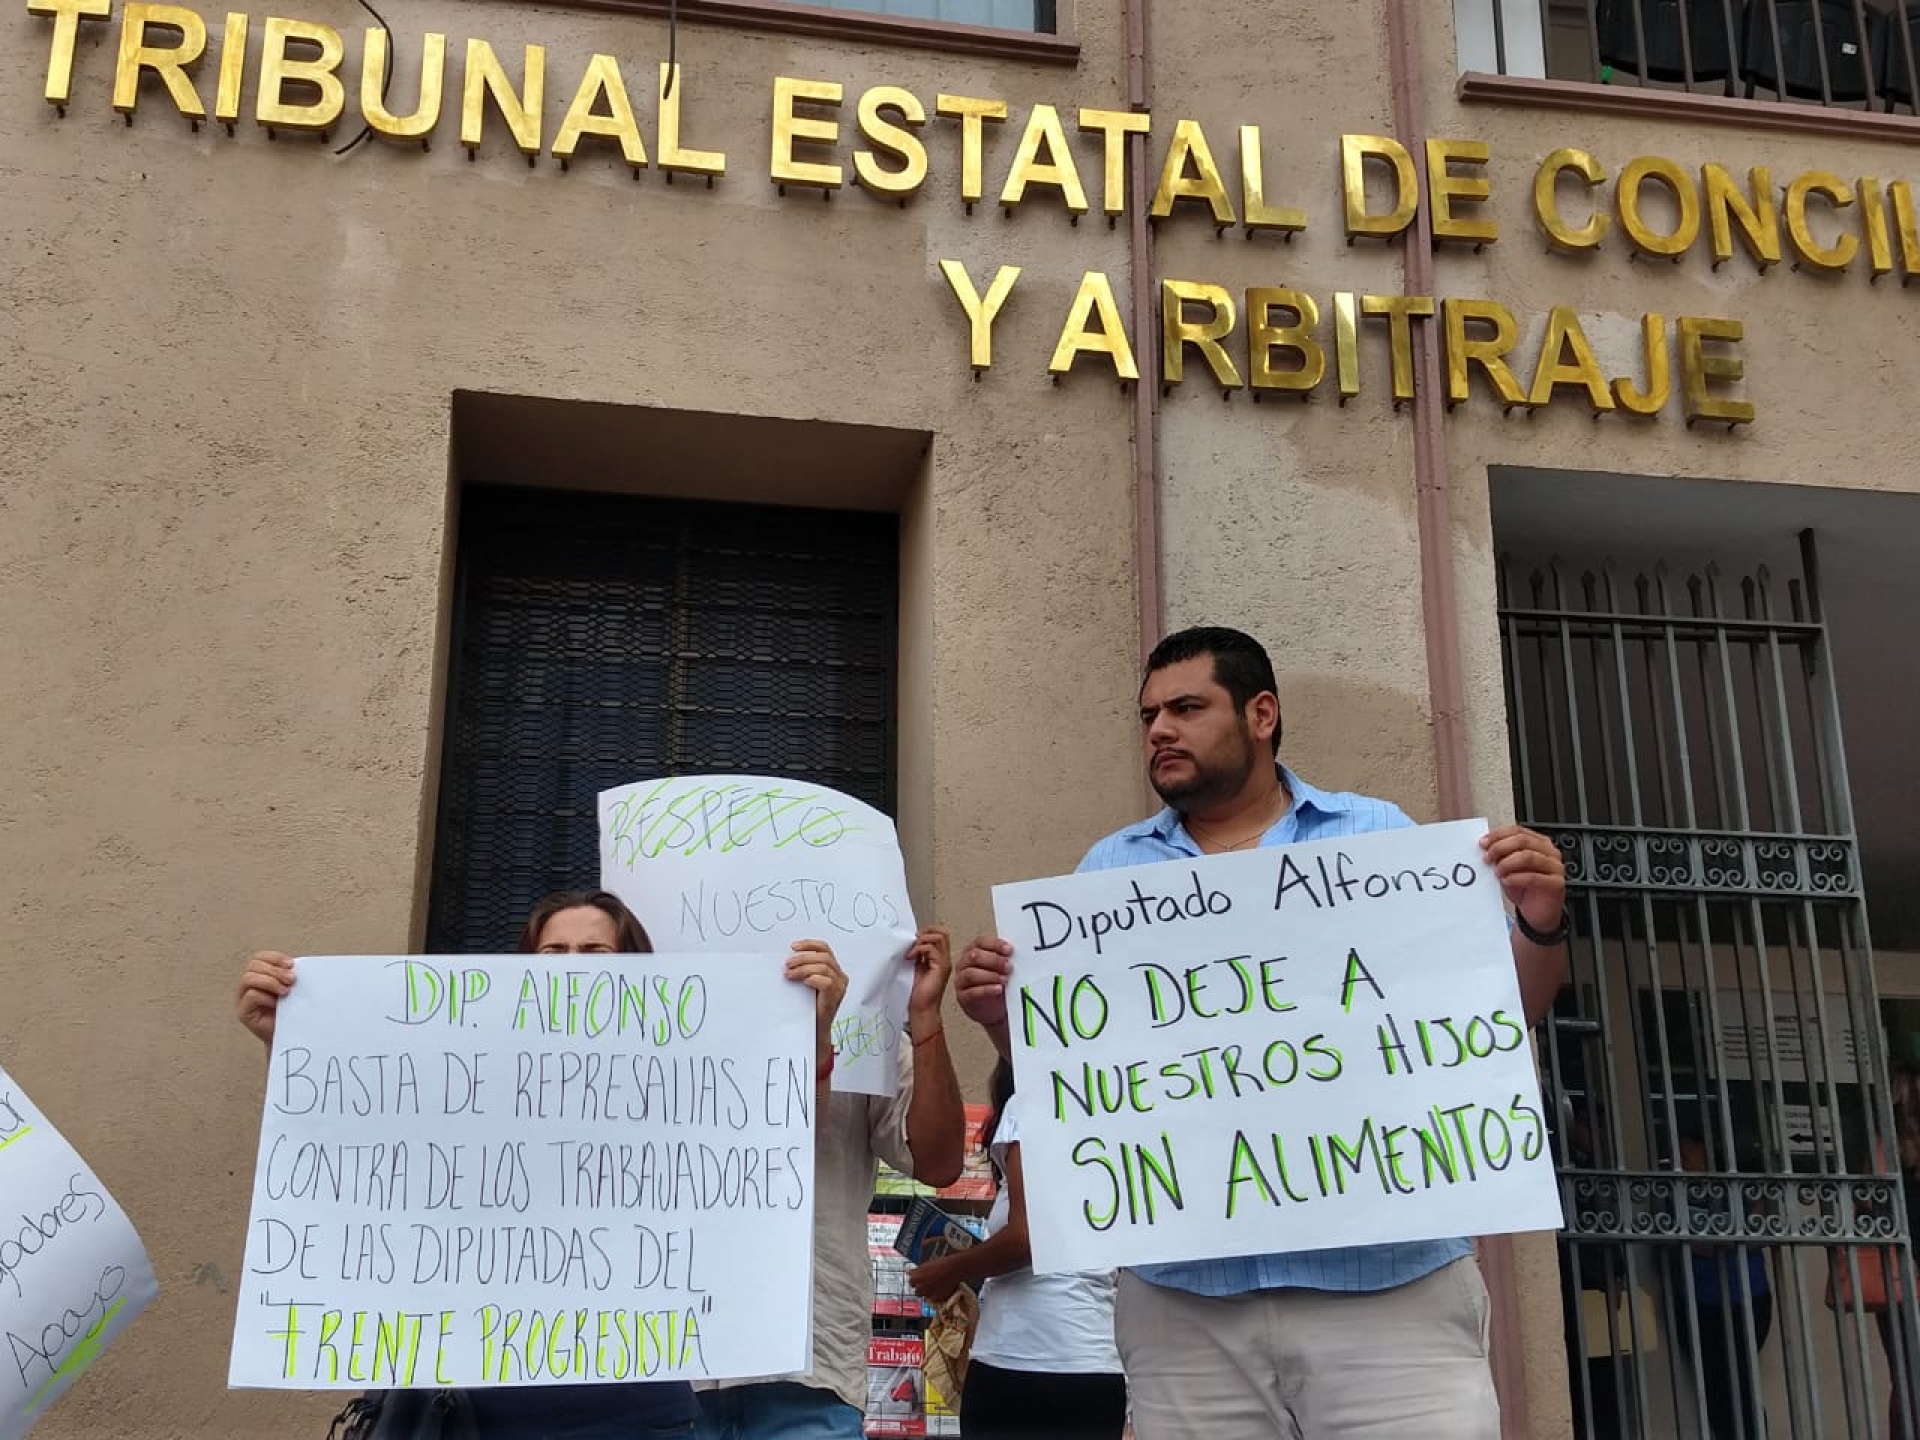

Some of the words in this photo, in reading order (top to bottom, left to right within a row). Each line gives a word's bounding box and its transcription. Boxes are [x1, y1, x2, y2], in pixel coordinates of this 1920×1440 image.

[28, 0, 725, 177] TRIBUNAL
[771, 77, 1307, 231] ESTATAL
[1341, 134, 1498, 243] DE
[938, 259, 1022, 371] Y
[1048, 271, 1755, 424] ARBITRAJE
[607, 787, 844, 872] RESPETO
[681, 877, 899, 942] NUESTROS
[1022, 871, 1232, 954] Diputado
[1274, 851, 1476, 911] Alfonso
[385, 960, 491, 1028] DIP.
[512, 970, 708, 1046] ALFONSO
[1020, 974, 1109, 1048] NO
[1129, 954, 1299, 1029] DEJE
[1341, 947, 1386, 1014] A
[273, 1048, 419, 1117] BASTA
[444, 1053, 489, 1116] DE
[516, 1051, 748, 1129] REPRESALIAS
[765, 1056, 809, 1129] EN
[1051, 1034, 1343, 1122] NUESTROS
[1377, 1010, 1525, 1077] HIJOS
[266, 1133, 408, 1210] CONTRA
[425, 1143, 464, 1211] DE
[479, 1142, 530, 1212] LOS
[547, 1140, 804, 1211] TRABAJADORES
[1072, 1130, 1184, 1231] SIN
[1226, 1094, 1545, 1219] ALIMENTOS
[251, 1218, 319, 1281] DE
[341, 1224, 395, 1284] LAS
[410, 1224, 611, 1290] DIPUTADAS
[633, 1224, 706, 1292] DEL
